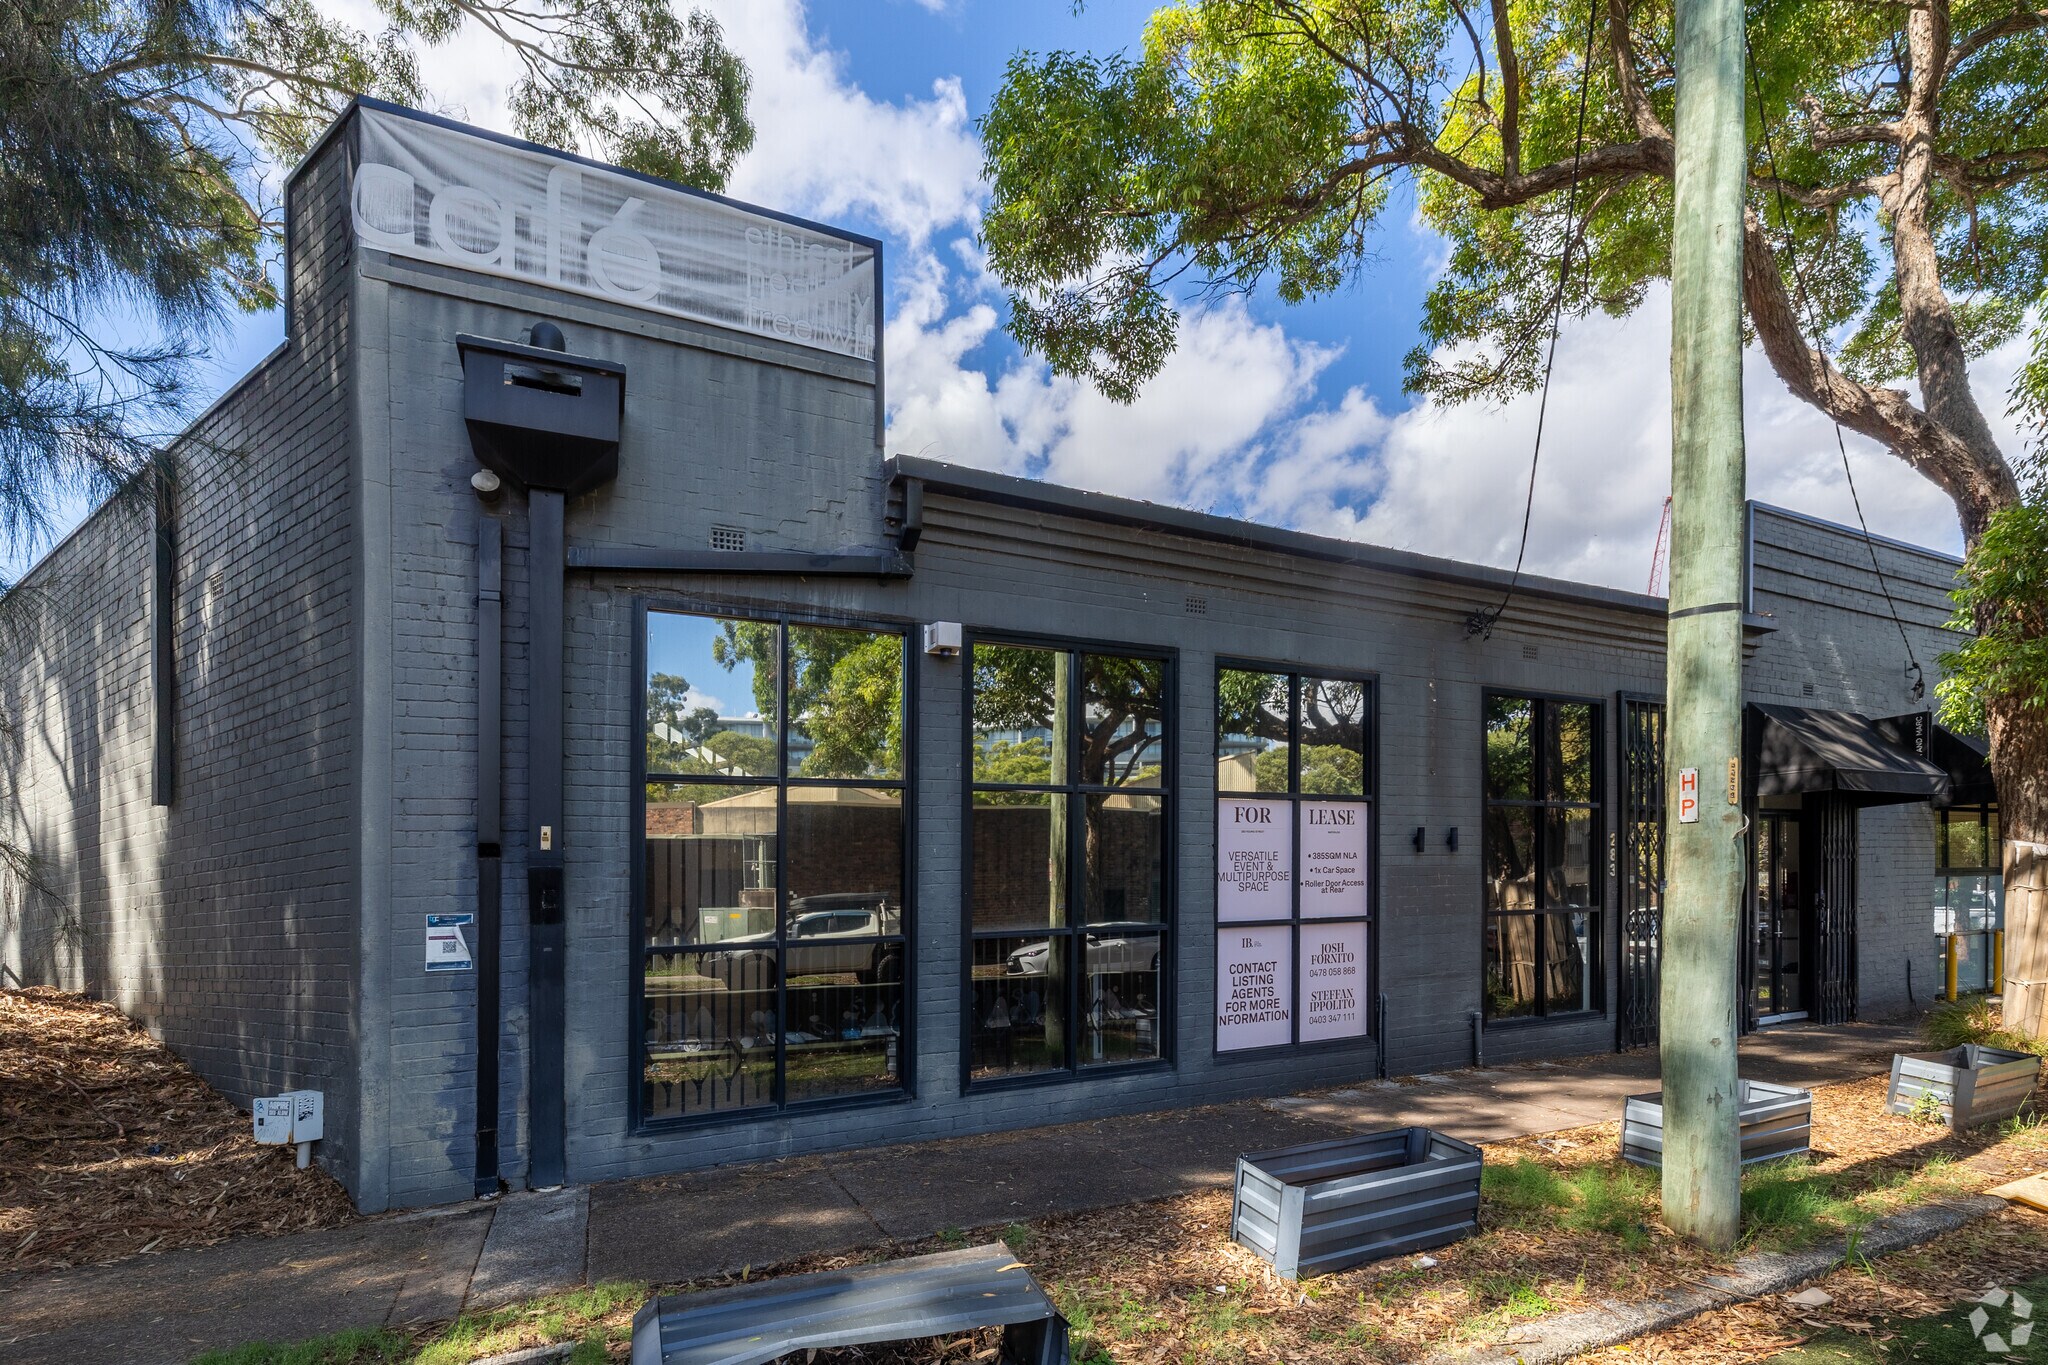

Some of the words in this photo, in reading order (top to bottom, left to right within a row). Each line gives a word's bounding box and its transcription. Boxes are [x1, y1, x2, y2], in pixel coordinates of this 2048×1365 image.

[1234, 806, 1272, 824] FOR
[1309, 809, 1355, 826] LEASE
[1228, 851, 1279, 861] VERSATILE
[1312, 852, 1342, 860] 385SQM
[1342, 851, 1358, 860] NLA
[1233, 861, 1264, 871] EVENT
[1266, 862, 1274, 871] &
[1336, 867, 1356, 875] Space
[1218, 871, 1290, 882] MULTIPURPOSE
[1238, 882, 1269, 892] SPACE
[1305, 880, 1325, 888] Roller
[1342, 879, 1364, 887] Access
[1329, 886, 1345, 894] Rear
[1321, 943, 1345, 955] JOSH
[1311, 952, 1354, 965] FORNITO
[1229, 961, 1277, 975] CONTACT
[1309, 968, 1327, 978] 0478
[1328, 967, 1342, 976] 058
[1232, 974, 1274, 987] LISTING
[1231, 986, 1274, 1000] AGENTS
[1311, 988, 1353, 1001] STEFFAN
[1225, 1000, 1246, 1013] FOR
[1249, 998, 1280, 1011] MORE
[1309, 999, 1355, 1012] IPPOLITO
[1219, 1009, 1289, 1026] NFORMATION
[1309, 1015, 1327, 1025] 0403
[1328, 1014, 1341, 1023] 347
[1342, 1012, 1355, 1022] 111
